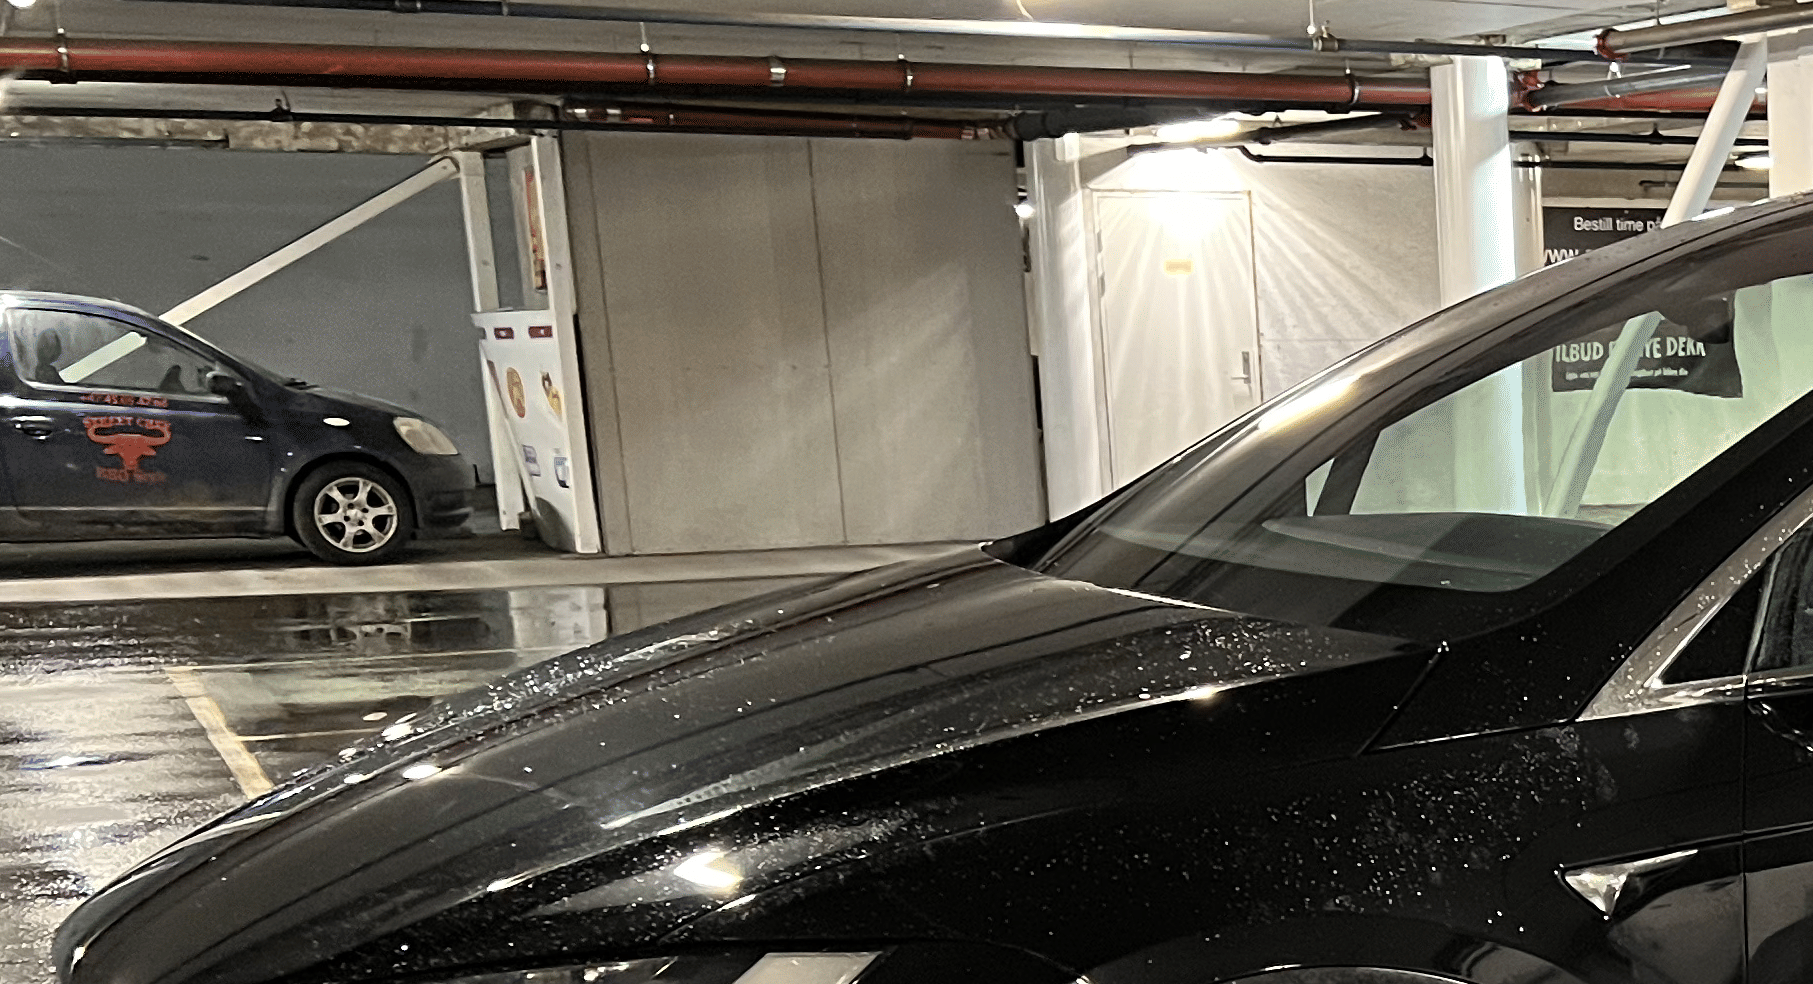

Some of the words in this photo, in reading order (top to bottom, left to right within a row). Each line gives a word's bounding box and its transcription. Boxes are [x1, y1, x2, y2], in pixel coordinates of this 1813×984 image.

[1573, 216, 1614, 232] Bestill
[1616, 217, 1644, 232] time
[1555, 341, 1604, 363] ILBUD
